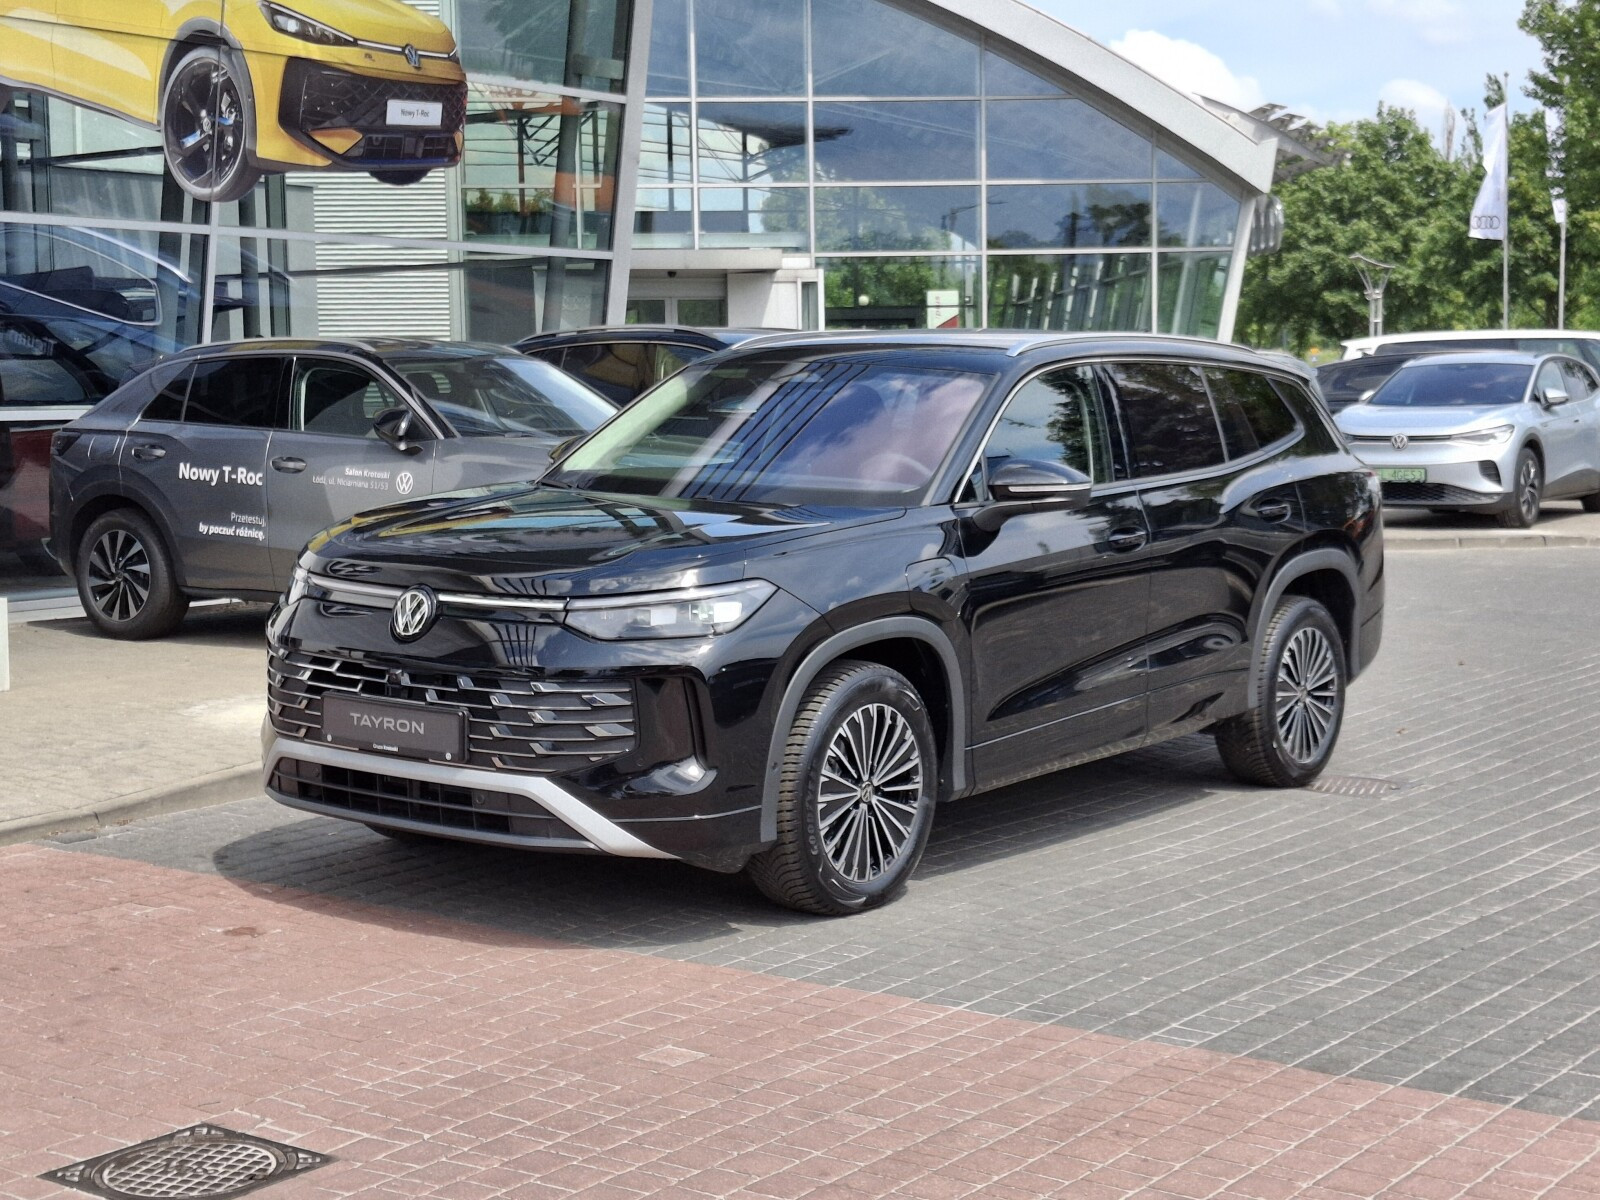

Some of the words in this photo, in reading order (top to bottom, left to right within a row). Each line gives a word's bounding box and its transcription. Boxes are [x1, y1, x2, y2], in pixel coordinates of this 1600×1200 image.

[178, 462, 220, 486] Nowy
[222, 465, 263, 486] T-Roc
[344, 467, 363, 477] Salon
[363, 469, 391, 479] Krotoski
[198, 521, 209, 535] by
[208, 525, 236, 537] poczuć
[350, 712, 425, 735] TAYRON
